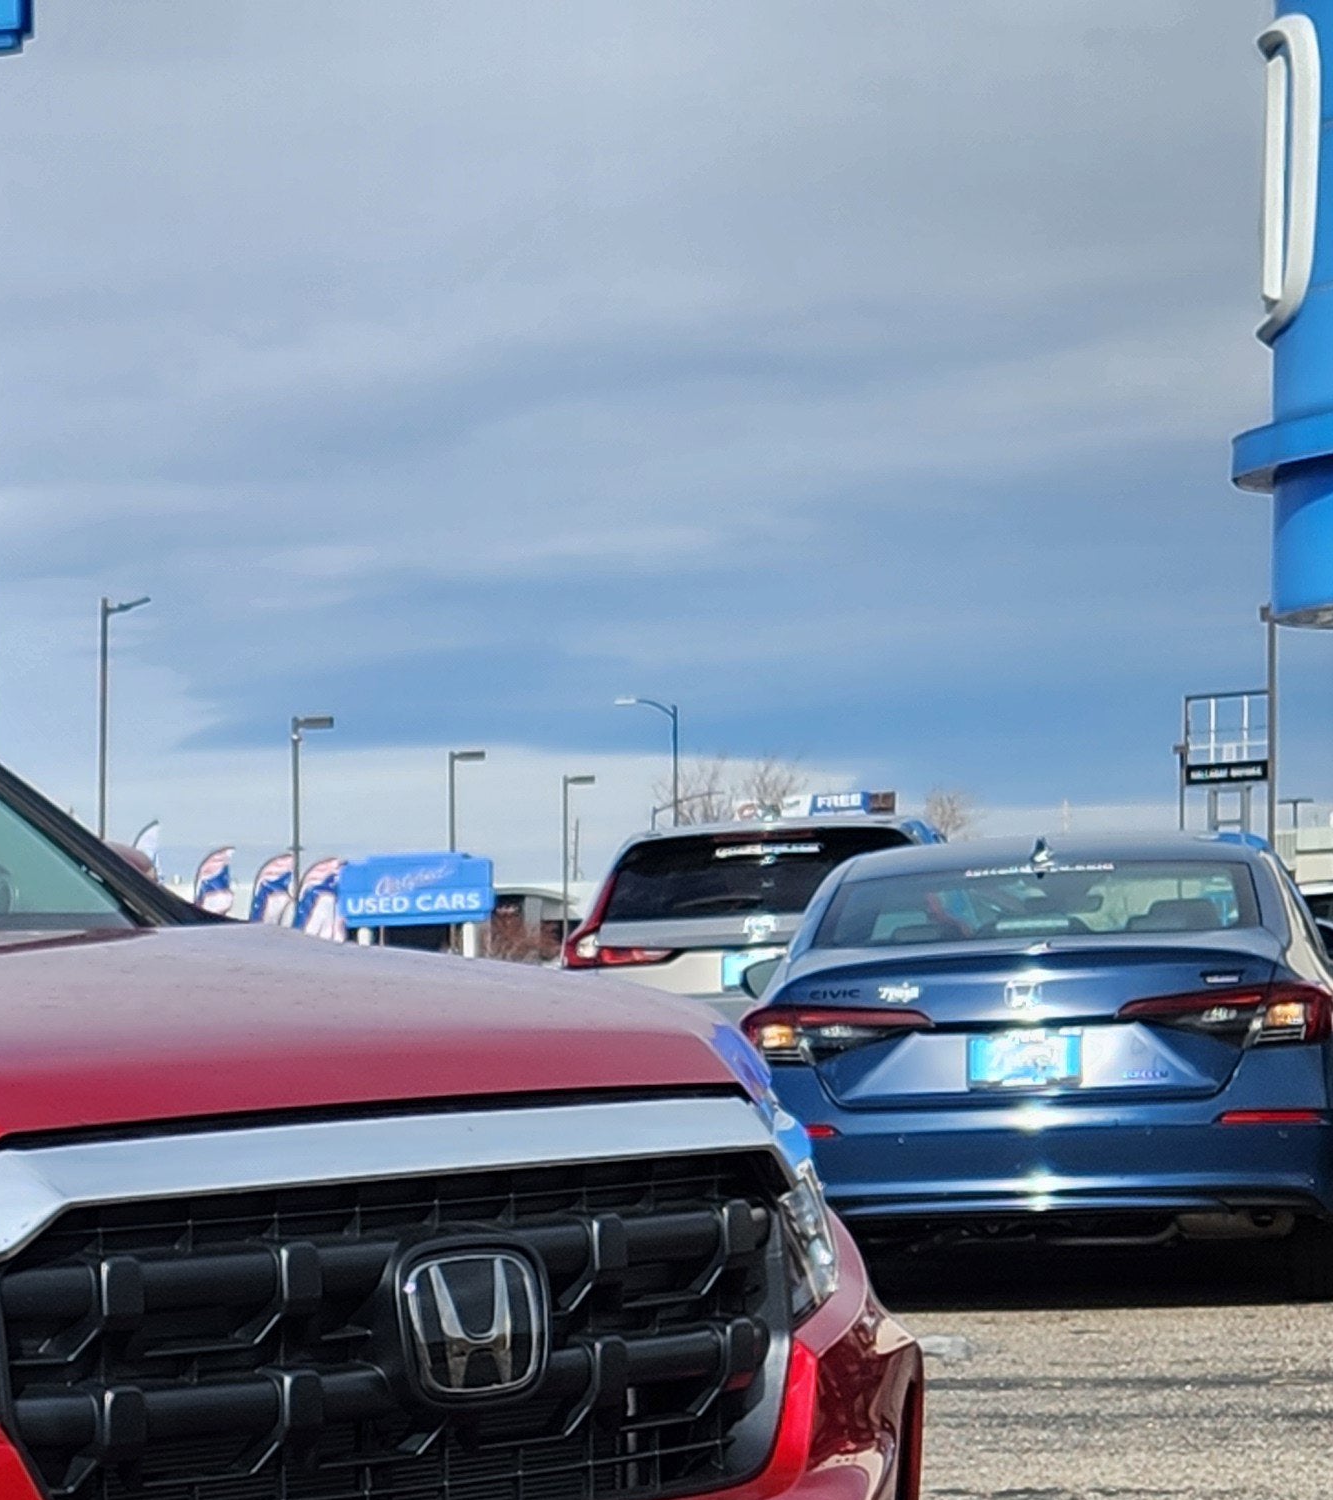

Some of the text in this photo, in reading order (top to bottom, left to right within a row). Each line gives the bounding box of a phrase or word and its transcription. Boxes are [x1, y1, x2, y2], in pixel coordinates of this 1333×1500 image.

[346, 892, 482, 915] USED CARS
[809, 988, 861, 1000] CIVIC
